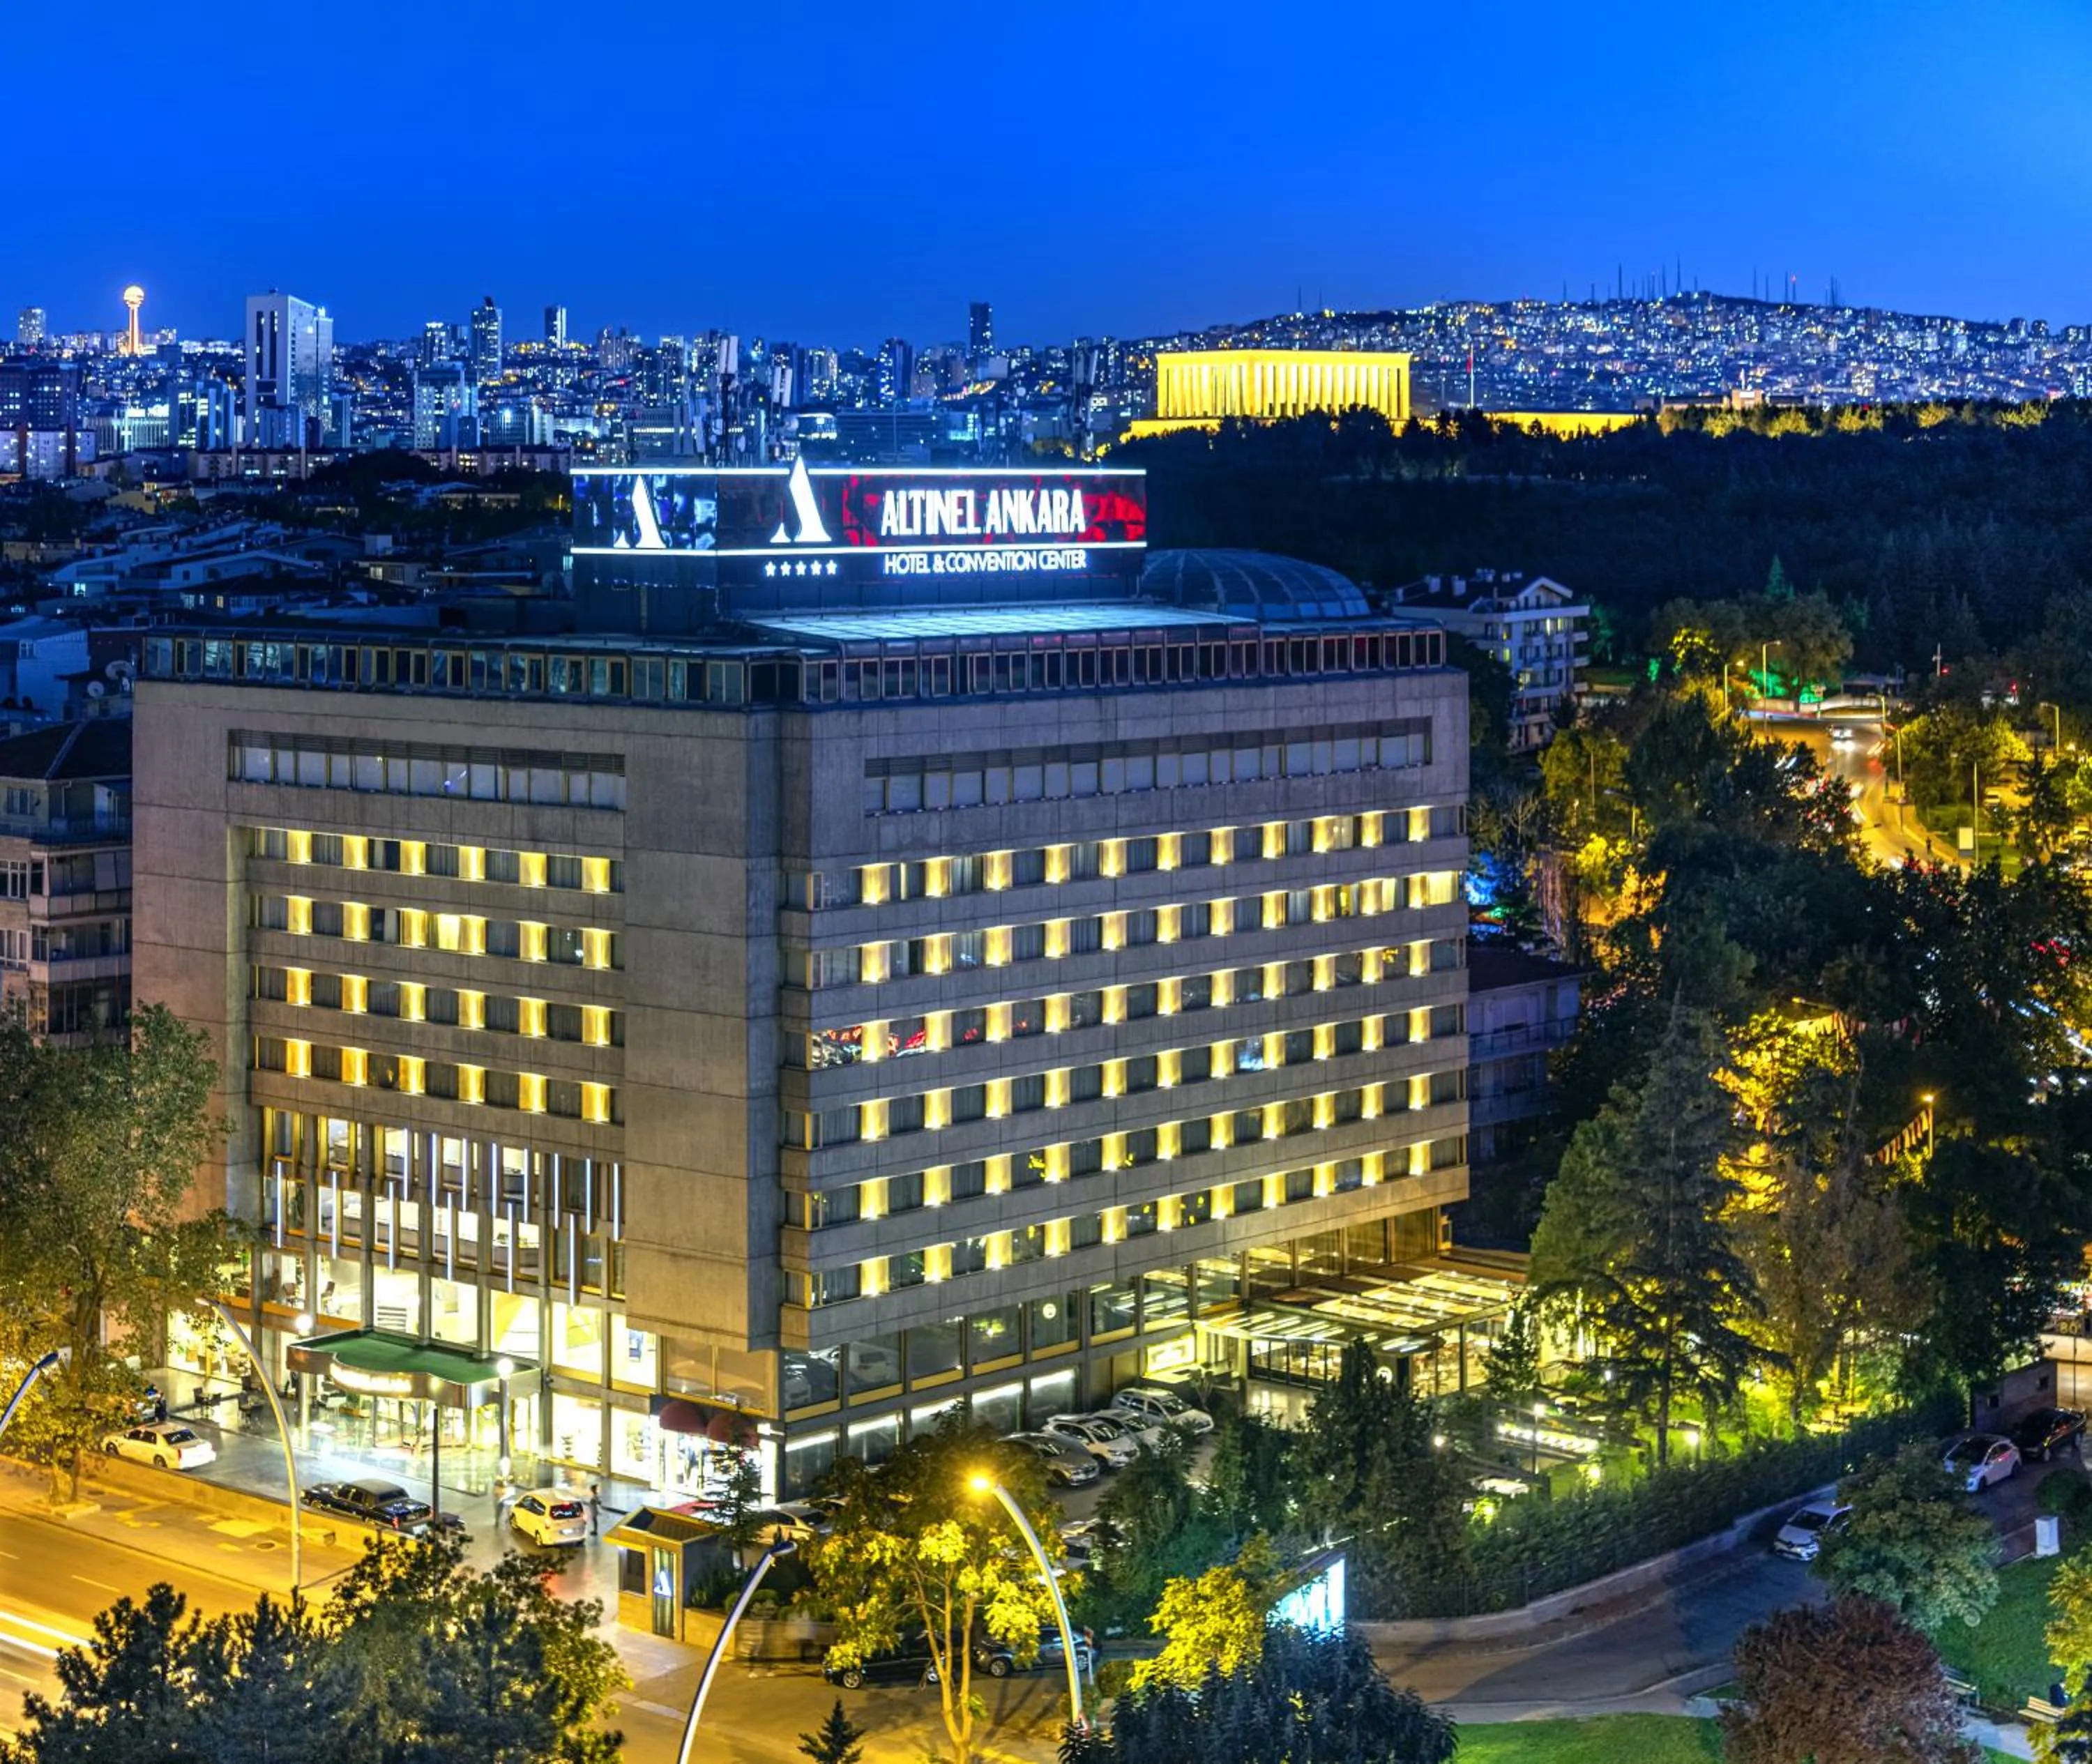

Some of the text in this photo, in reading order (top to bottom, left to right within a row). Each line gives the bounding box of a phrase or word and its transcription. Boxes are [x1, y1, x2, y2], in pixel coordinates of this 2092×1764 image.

[881, 489, 1086, 536] ALTINEL ANKARA
[884, 553, 930, 575] HOTEL
[1038, 549, 1086, 570] CENTER
